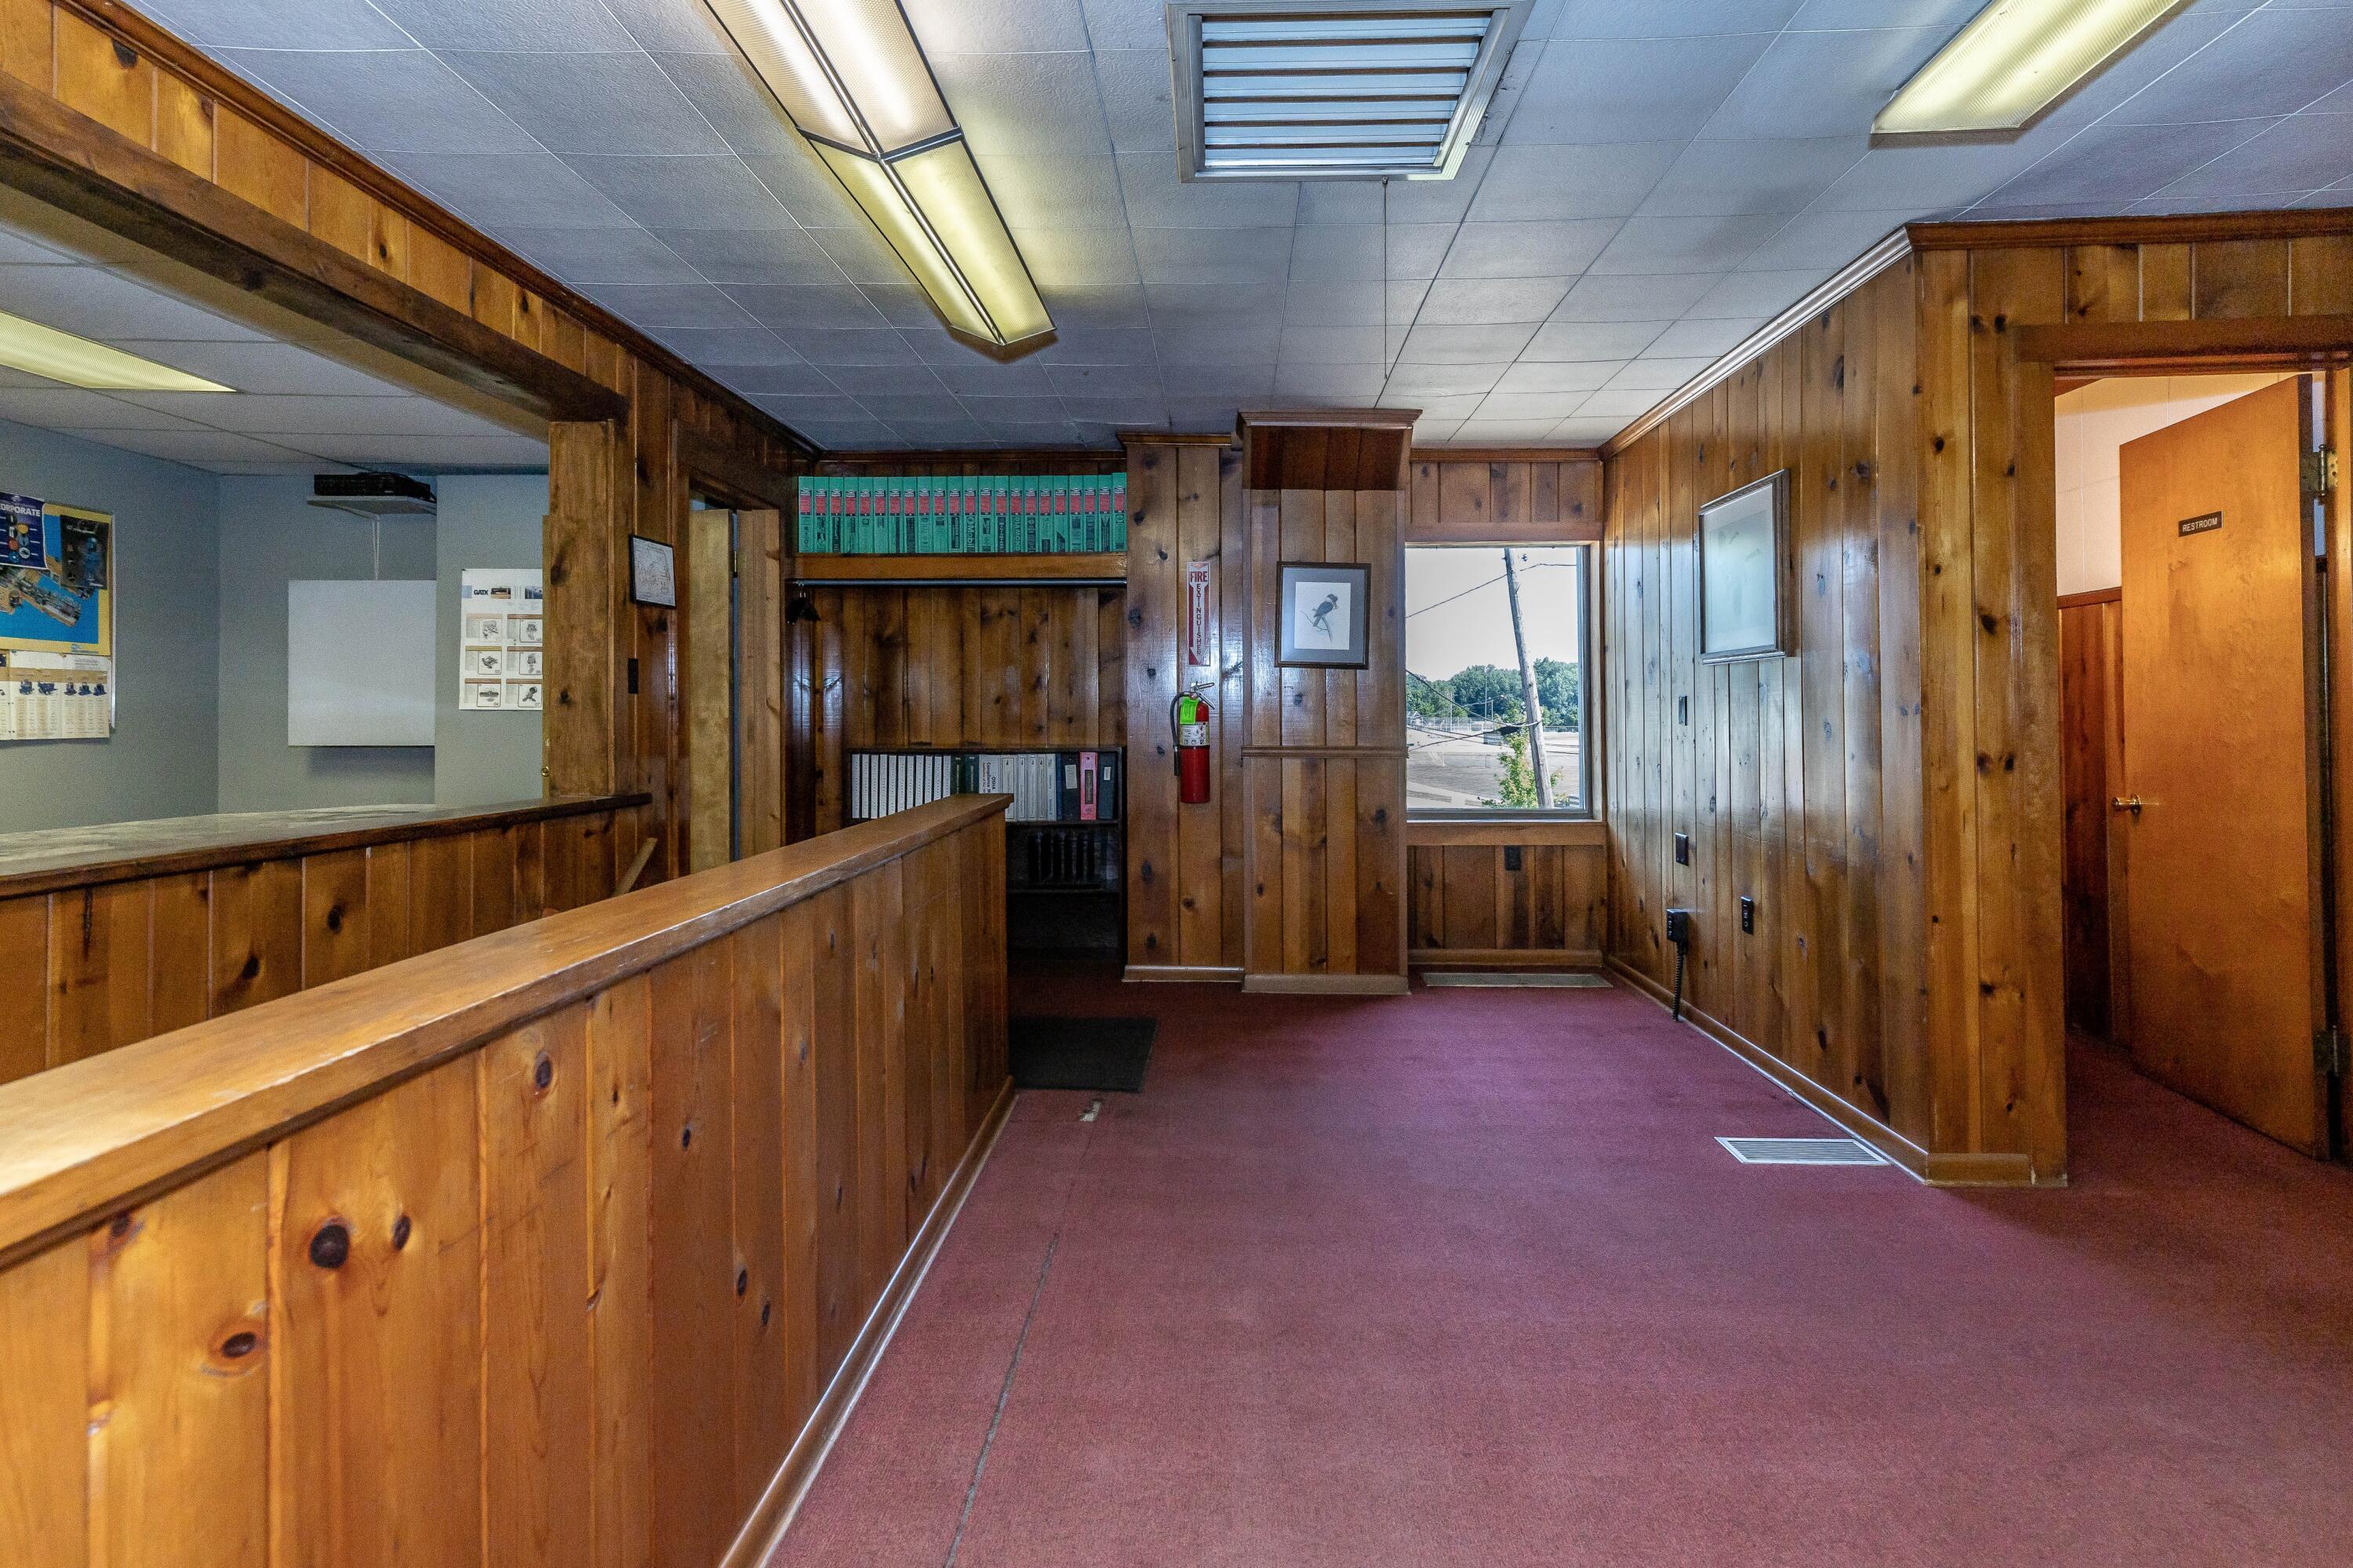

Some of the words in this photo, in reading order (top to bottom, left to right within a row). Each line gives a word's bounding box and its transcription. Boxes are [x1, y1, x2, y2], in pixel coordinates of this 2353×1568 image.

[0, 503, 41, 517] ORPORATE
[2182, 517, 2218, 533] RESTROOM
[1190, 571, 1208, 583] FIRE
